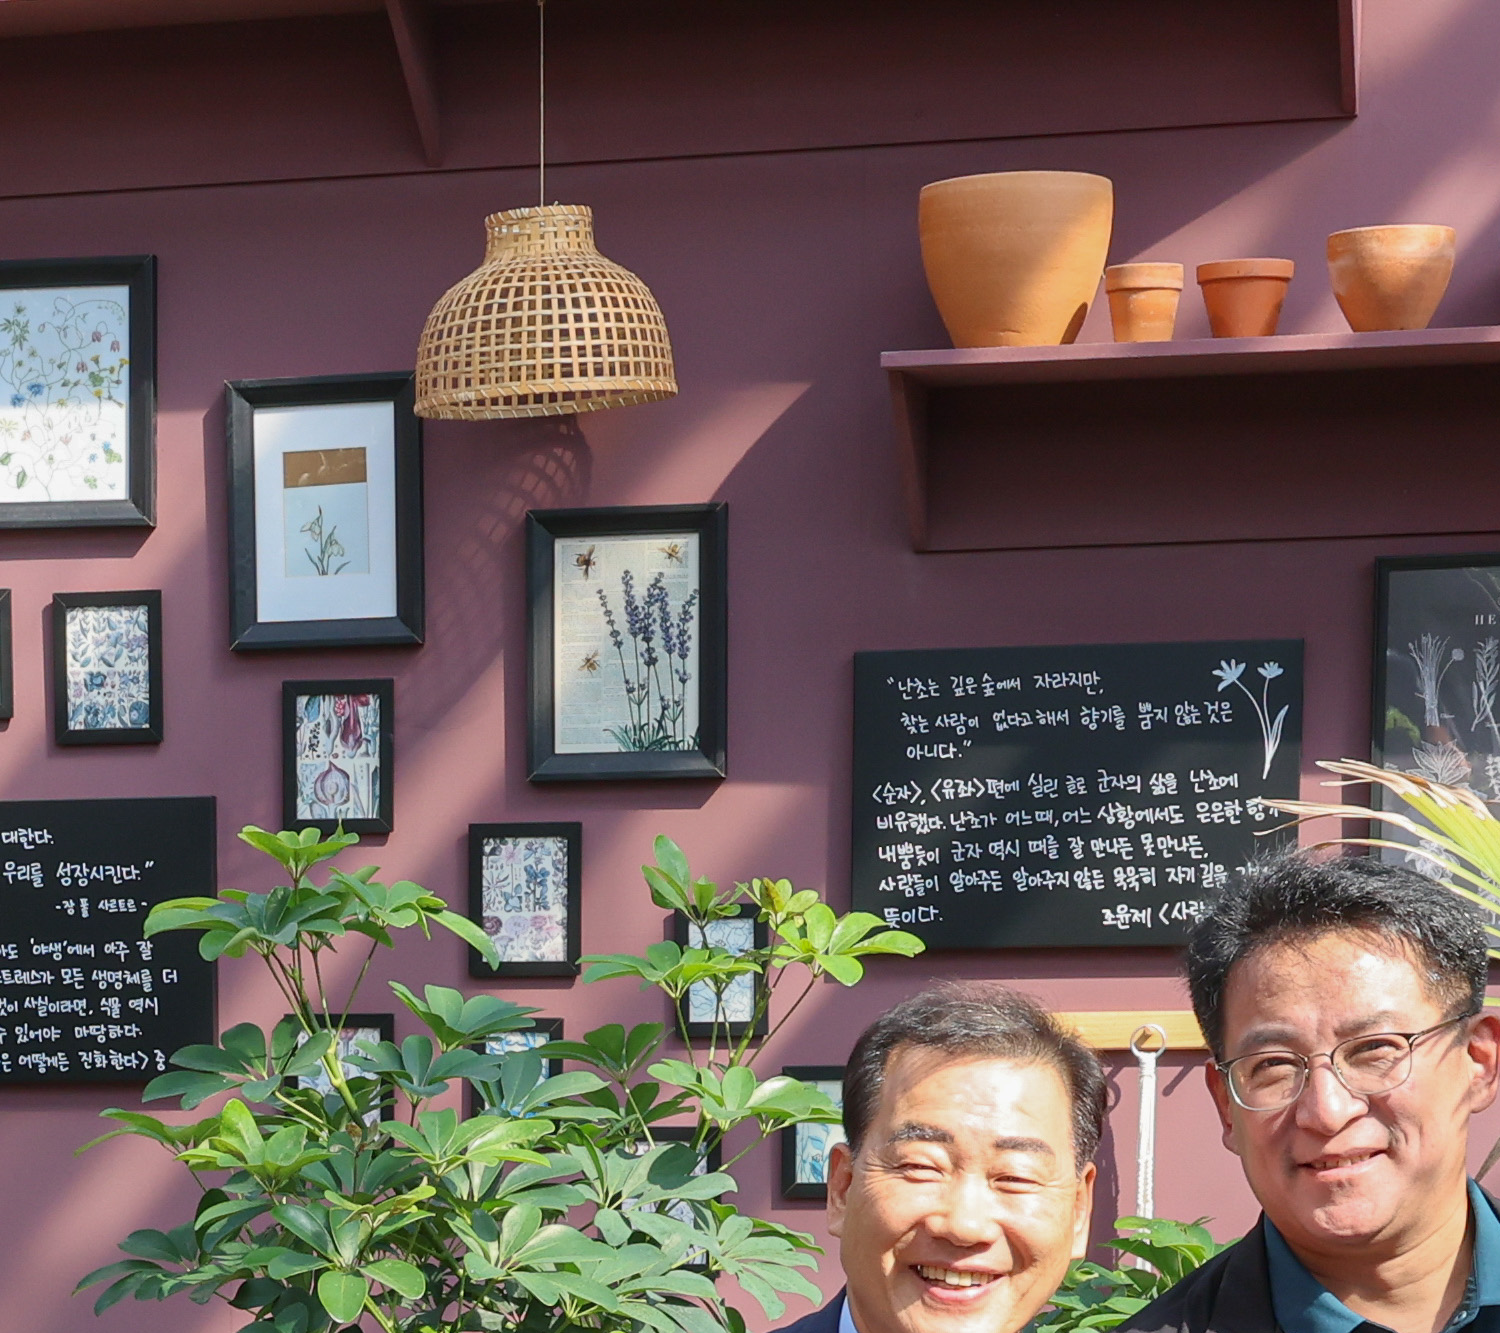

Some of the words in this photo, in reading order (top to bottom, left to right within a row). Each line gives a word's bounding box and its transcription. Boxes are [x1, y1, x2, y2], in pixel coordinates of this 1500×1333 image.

[950, 676, 978, 696] 깊은
[981, 674, 1021, 697] 숲에서
[1034, 674, 1104, 694] 자라지만,
[900, 712, 929, 735] 찾는
[935, 714, 979, 735] 사람이
[1080, 705, 1126, 730] 향기를
[1138, 703, 1168, 725] 뿜지
[1028, 772, 1058, 798] 실린
[1064, 775, 1087, 795] 글로
[1097, 769, 1141, 794] 군자의
[1149, 771, 1178, 792] 삶을
[1189, 770, 1239, 792] 난초에
[876, 811, 946, 834] 비유했다.
[950, 811, 998, 831] 난초가
[1062, 806, 1092, 824] 어느
[1097, 803, 1184, 830] 상황에서도
[1195, 798, 1243, 823] 은은한
[1, 827, 55, 848] 대한다.
[878, 844, 939, 866] 내뿜듯이
[951, 841, 983, 862] 군자
[988, 840, 1020, 858] 역시
[1028, 834, 1059, 857] 때를
[1067, 836, 1084, 857] 잘
[1090, 834, 1135, 856] 만나든
[3, 861, 44, 889] 우리를
[878, 873, 939, 897] 사람들이
[949, 870, 1002, 894] 알아주든
[1011, 869, 1070, 892] 알아주지
[1073, 867, 1105, 891] 않든
[1113, 867, 1157, 891] 묵묵히
[1165, 866, 1197, 885] 자기
[80, 898, 90, 918] 폴
[883, 906, 944, 928] 뜻이다.
[1101, 909, 1151, 929] 조윤제
[104, 942, 129, 961] 아주
[136, 940, 154, 960] 잘
[61, 969, 85, 987] 모든
[91, 968, 152, 993] 생명체를
[162, 970, 177, 985] 더
[24, 997, 93, 1017] 사실이라면,
[100, 998, 121, 1018] 식물
[129, 996, 159, 1016] 역시
[16, 1026, 61, 1044] 있어야
[75, 1024, 142, 1044] 마땅하다.
[19, 1050, 69, 1074] 어떻게든
[153, 1049, 167, 1071] 중
